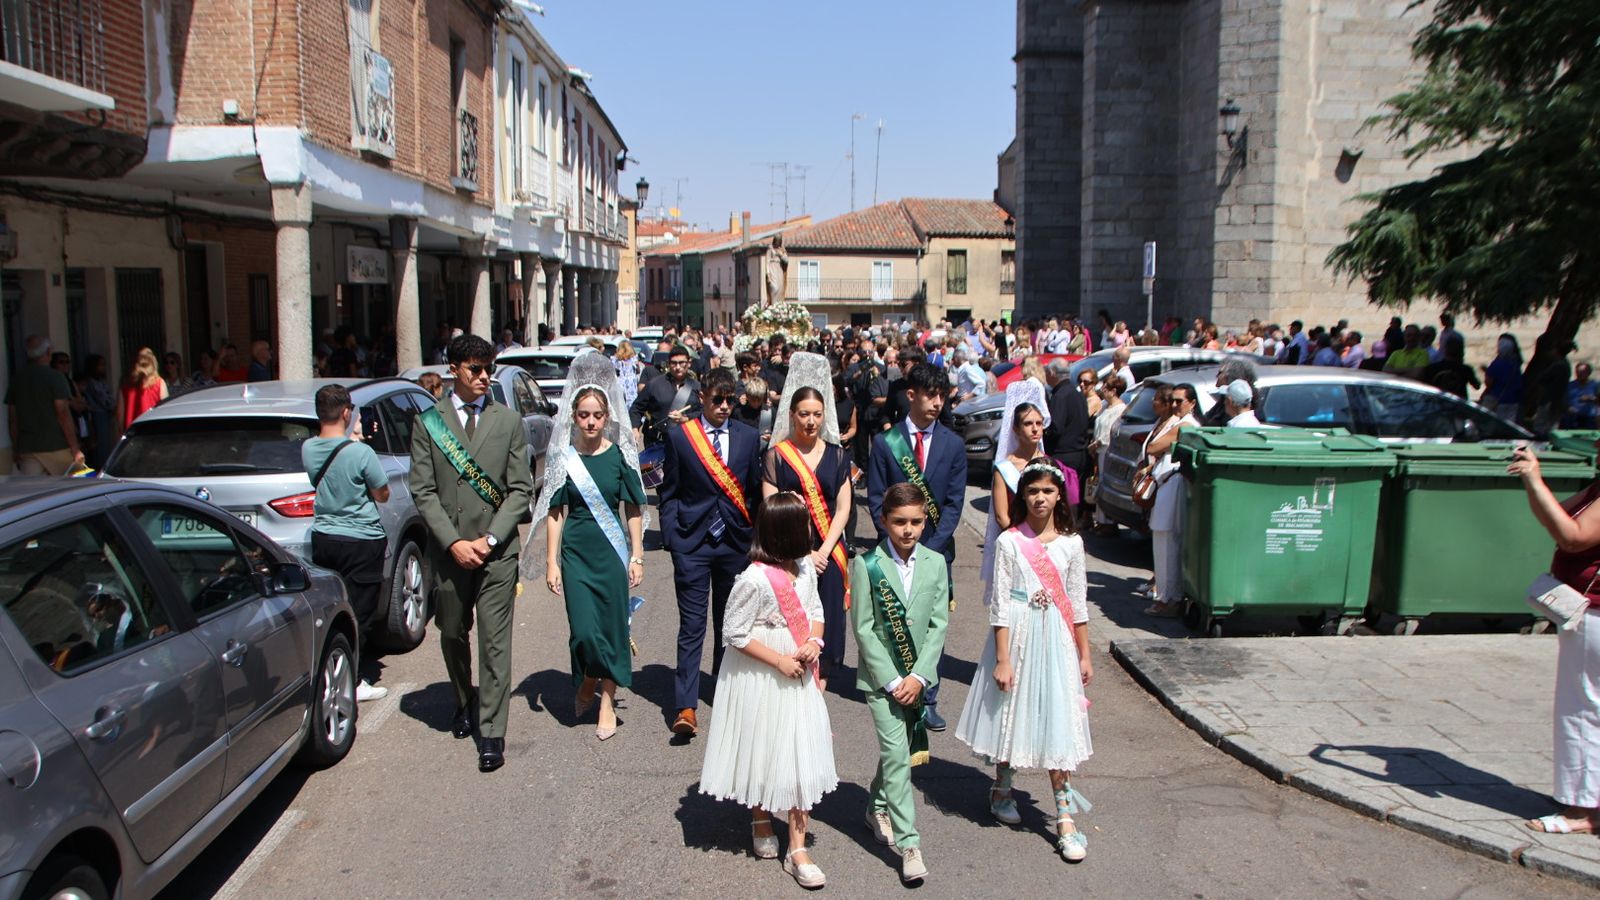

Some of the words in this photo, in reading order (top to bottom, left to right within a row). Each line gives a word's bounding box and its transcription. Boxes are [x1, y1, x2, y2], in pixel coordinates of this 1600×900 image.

[440, 433, 480, 481] CABALLERO
[174, 518, 214, 531] 708
[880, 579, 906, 642] CABALLERO
